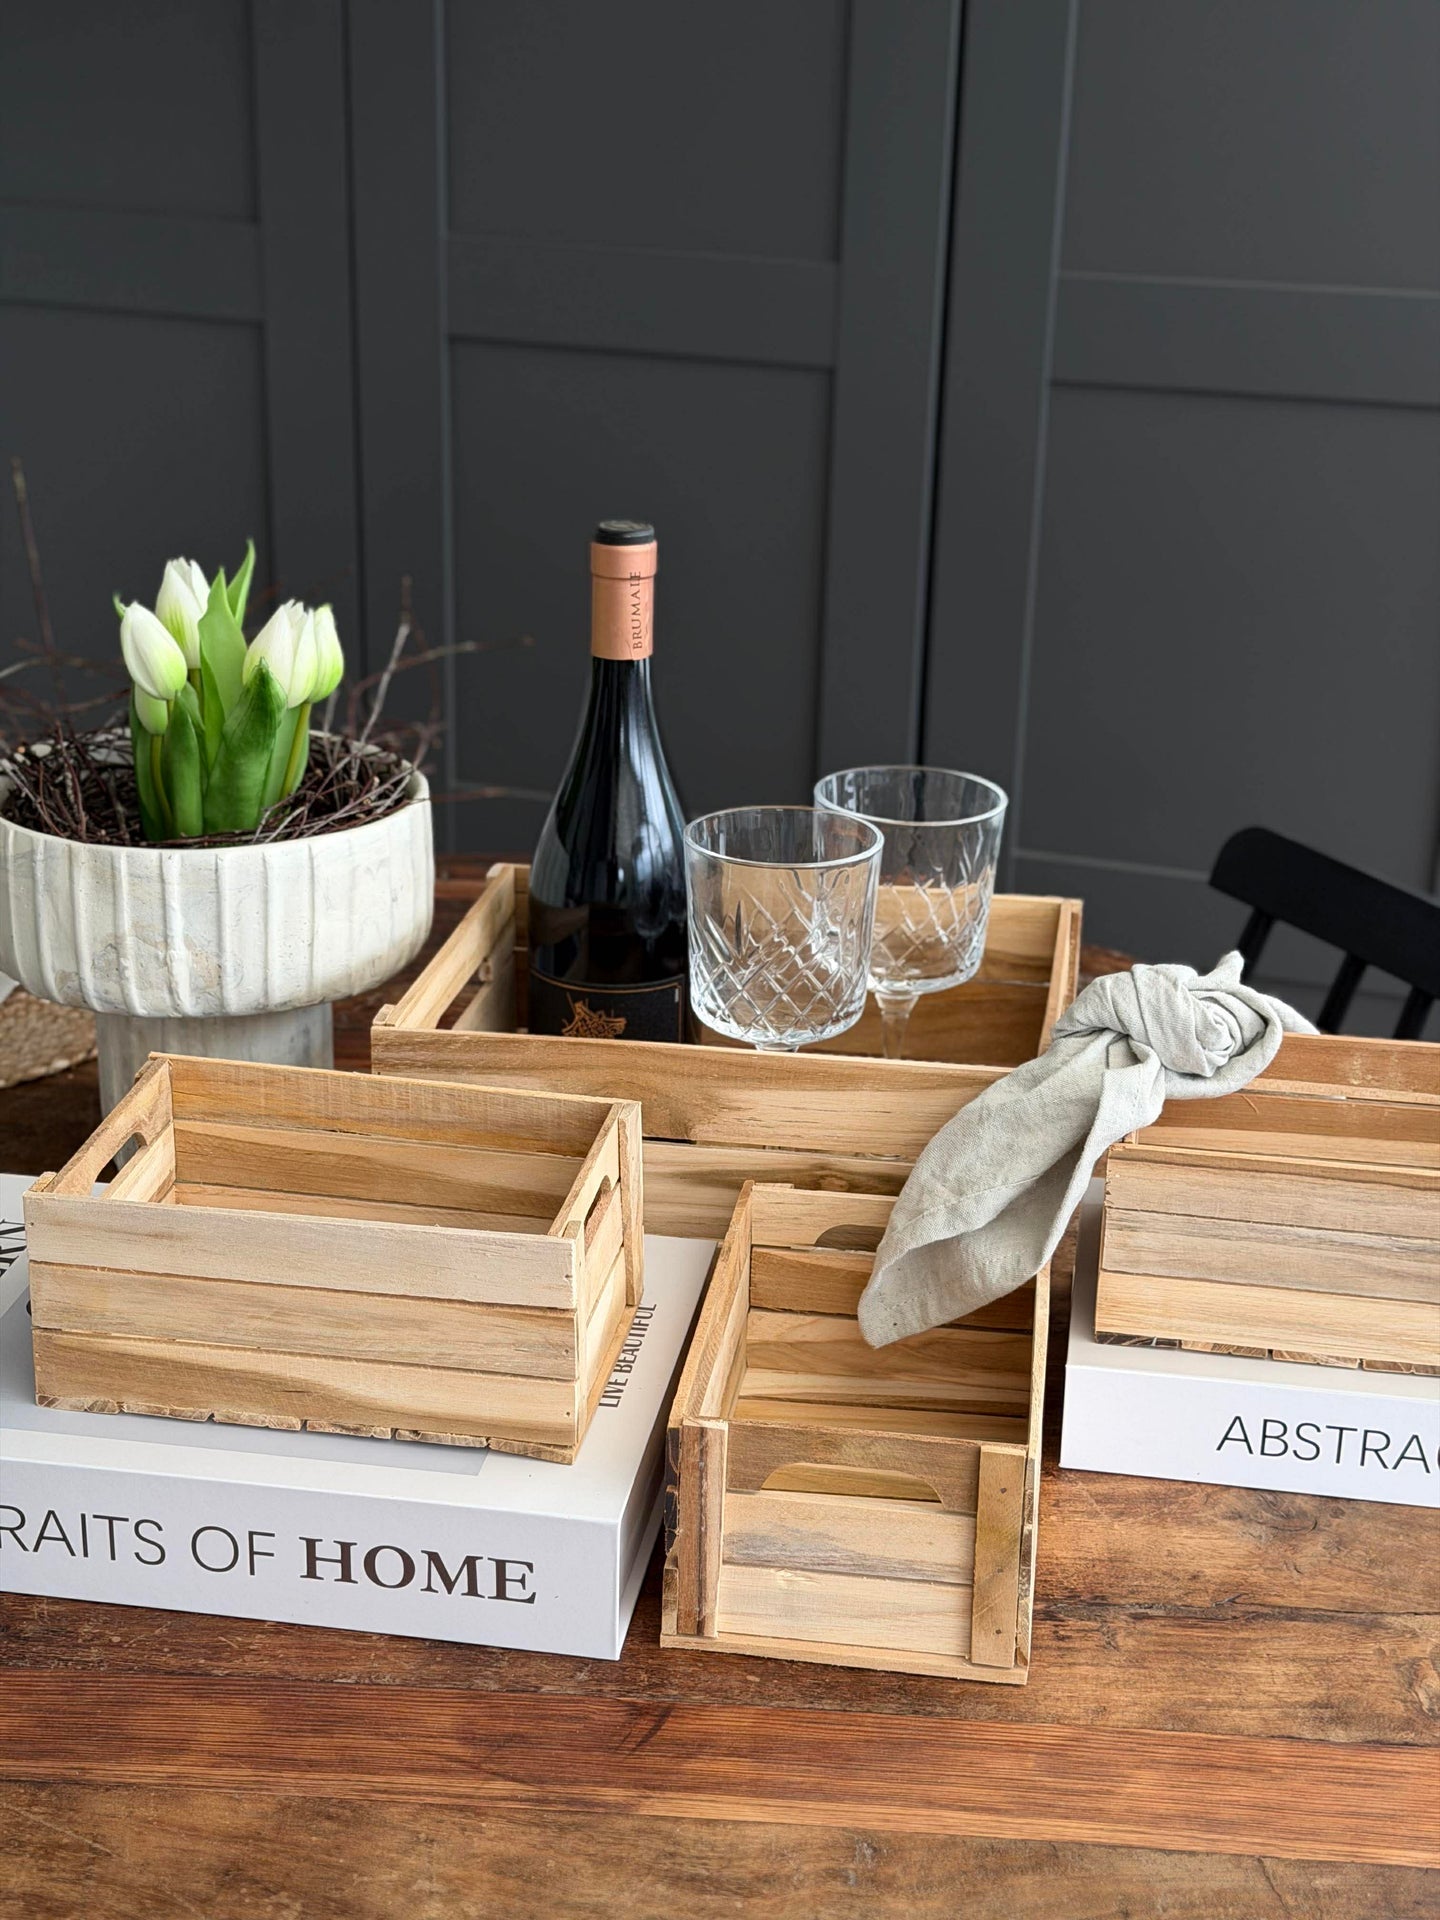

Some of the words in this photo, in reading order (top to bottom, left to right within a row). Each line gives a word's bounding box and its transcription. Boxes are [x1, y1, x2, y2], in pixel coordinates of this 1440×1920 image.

[598, 1378, 629, 1408] LIVE
[1215, 1415, 1440, 1474] ABSTRA
[191, 1525, 276, 1576] OF
[299, 1536, 537, 1605] HOME
